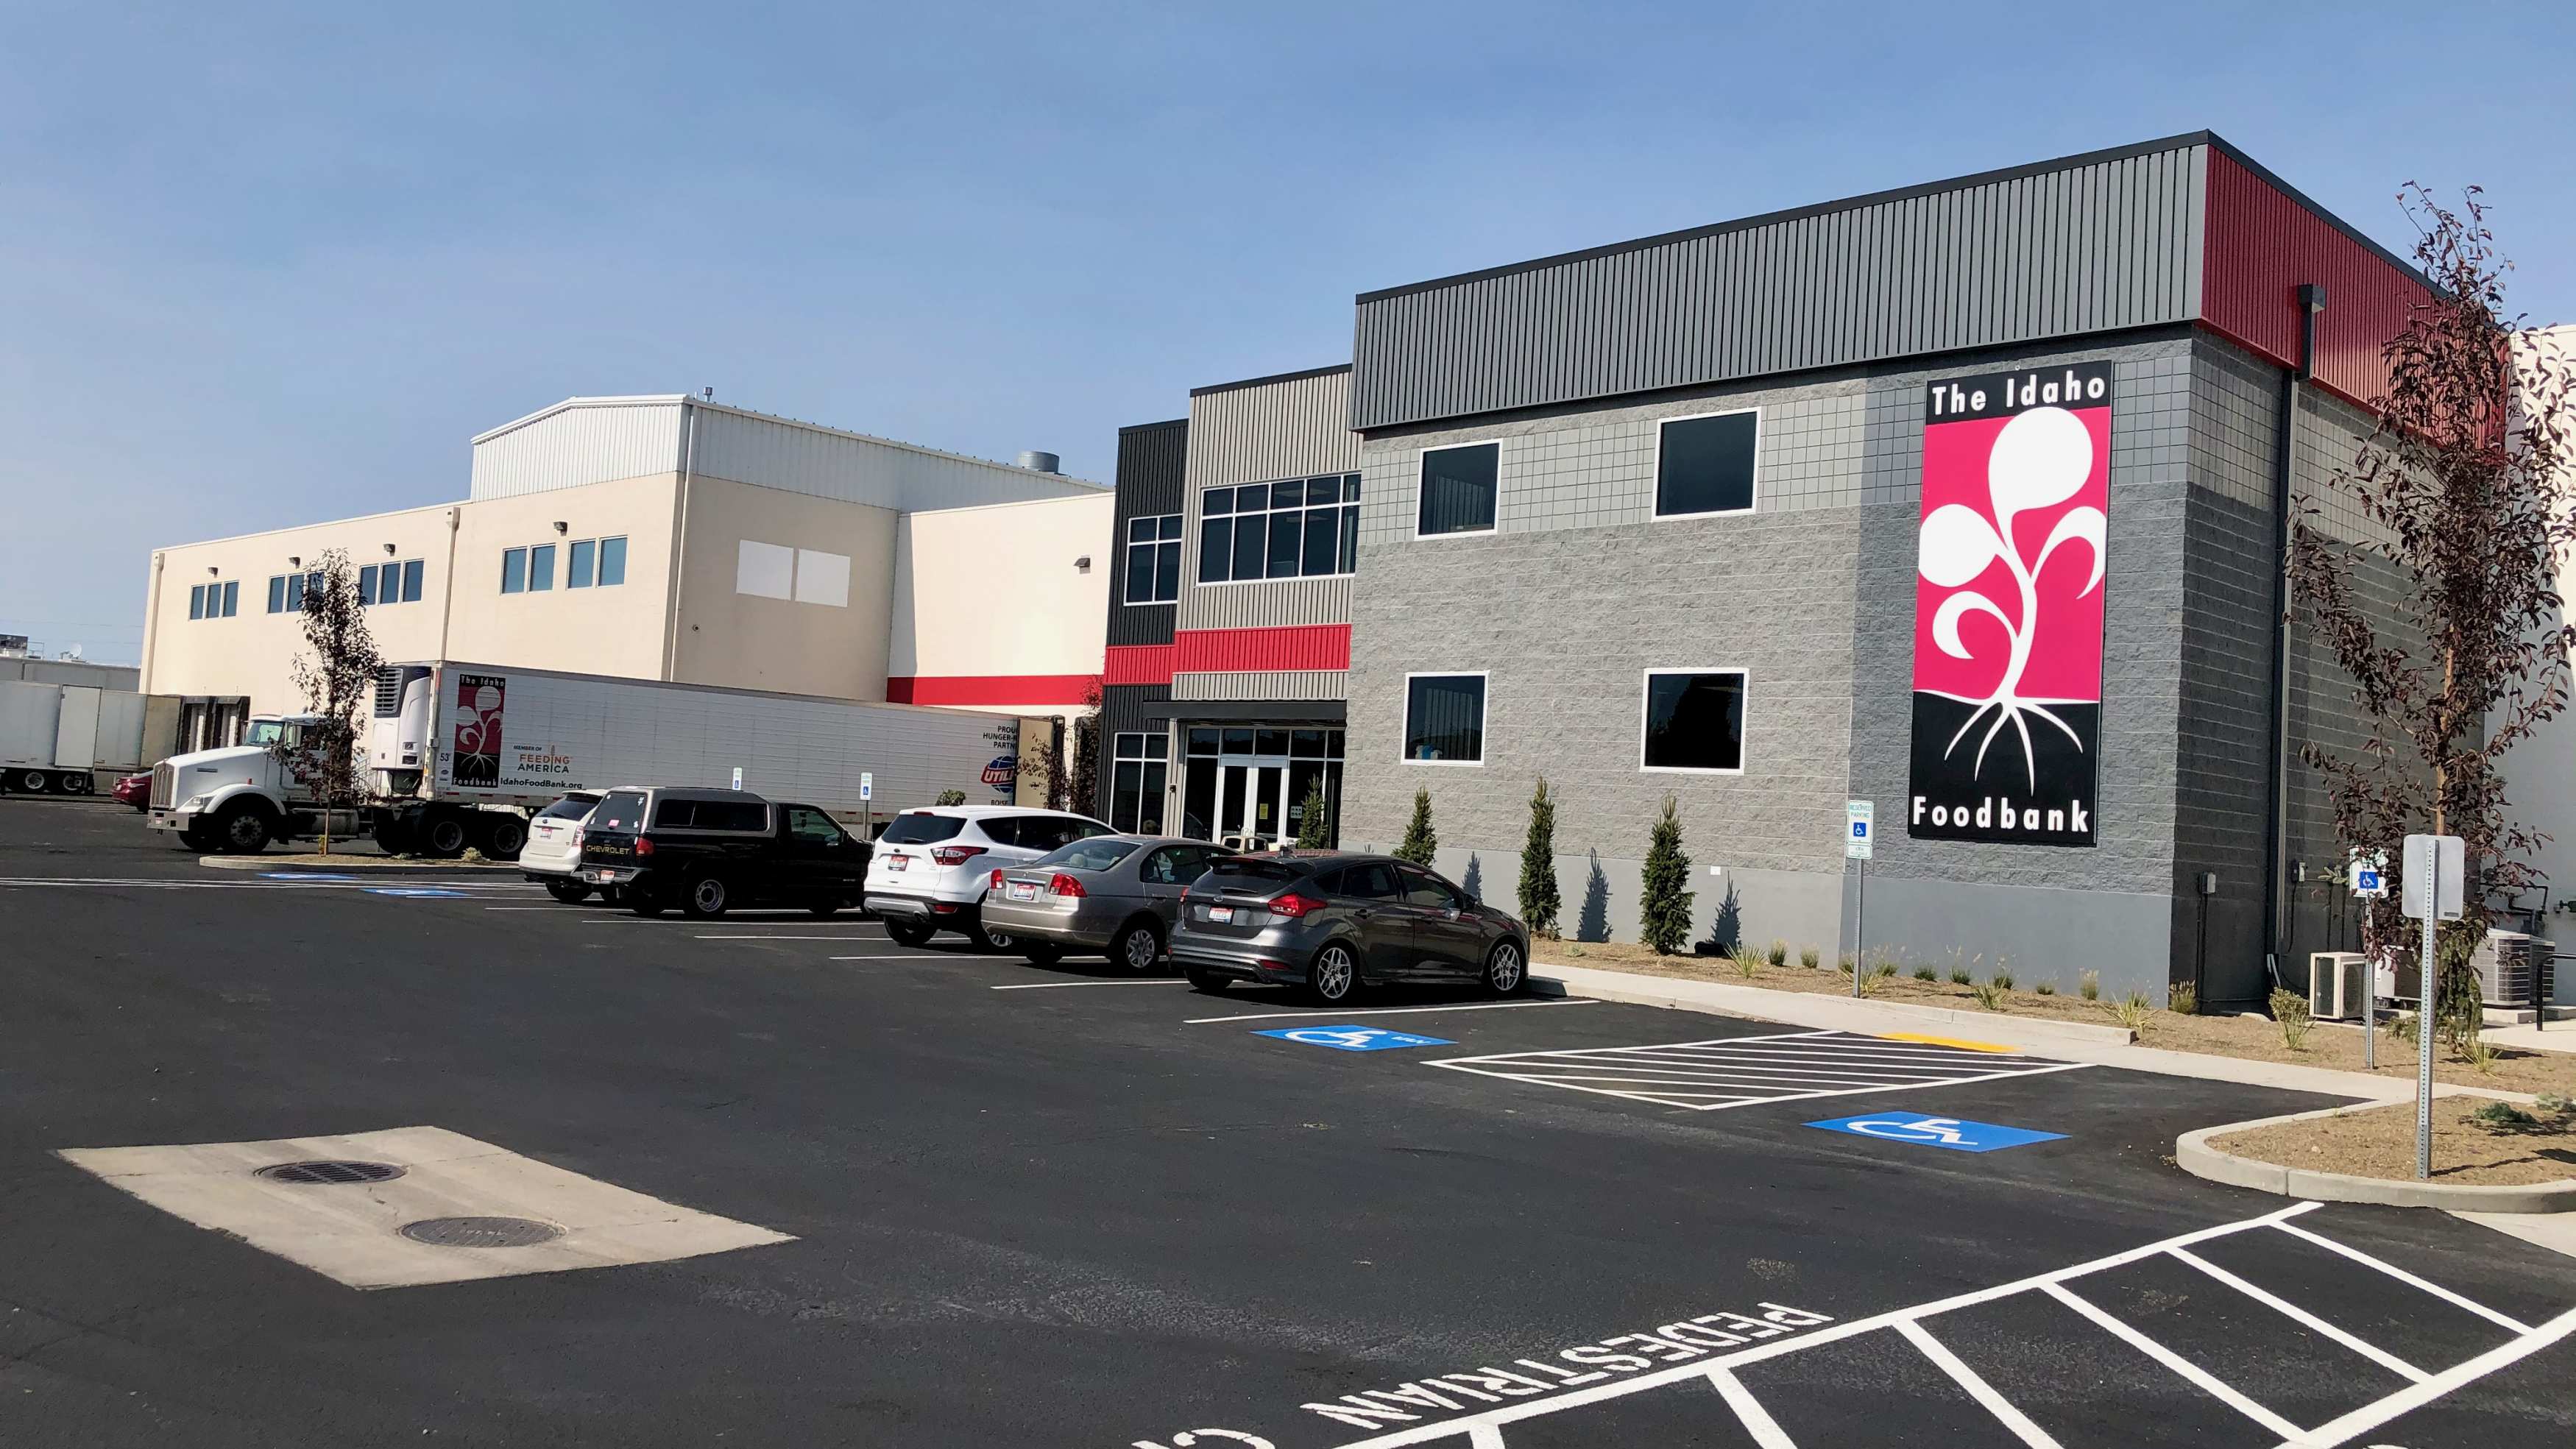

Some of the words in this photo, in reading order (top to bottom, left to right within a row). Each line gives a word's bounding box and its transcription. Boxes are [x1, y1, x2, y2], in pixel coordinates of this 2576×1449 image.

[1932, 383, 1986, 415] The
[2006, 370, 2106, 408] Idaho
[461, 675, 475, 684] The
[481, 677, 504, 687] Idaho
[997, 725, 1016, 734] PROU
[993, 741, 1016, 749] PARTN
[519, 754, 570, 765] FEEDING
[517, 763, 570, 773] AMERICA
[453, 777, 497, 786] Foodbank
[984, 770, 1013, 782] UTIL
[500, 777, 583, 790] IdahoFoodBank.org
[1913, 796, 2089, 832] Foodbank
[586, 845, 630, 854] CHEVROLET
[1300, 1302, 1836, 1430] PEDESTRIAN
